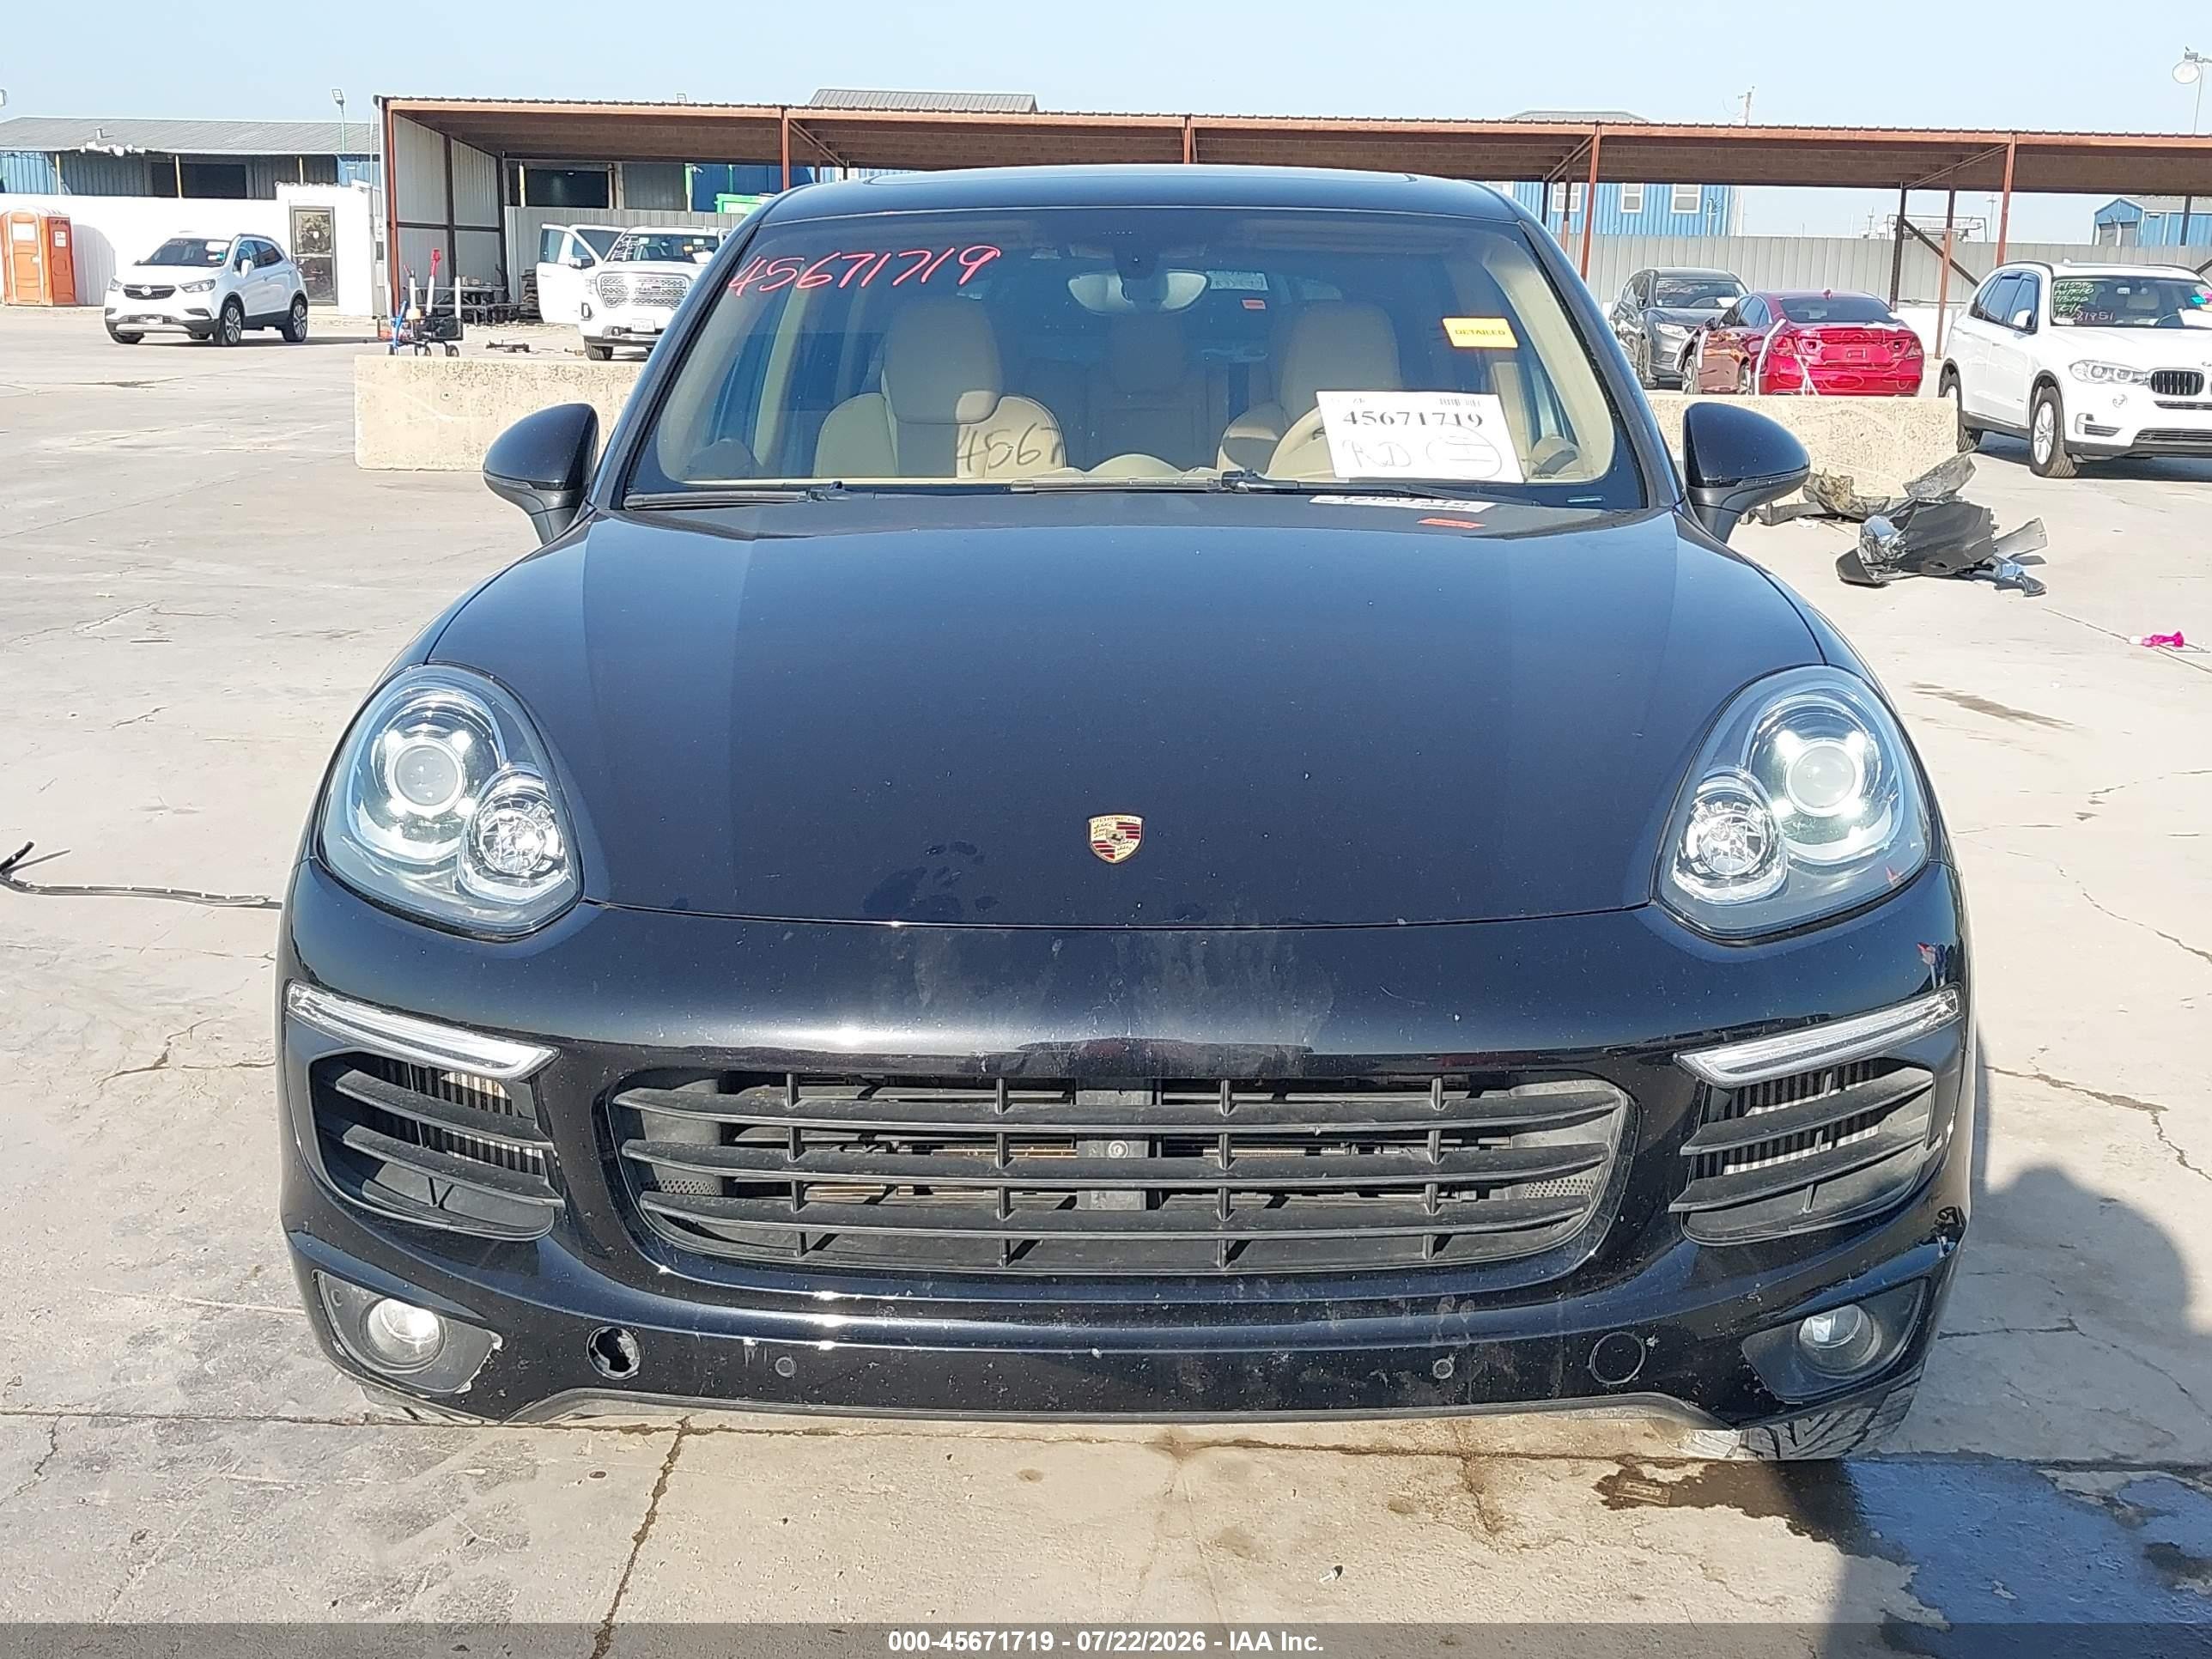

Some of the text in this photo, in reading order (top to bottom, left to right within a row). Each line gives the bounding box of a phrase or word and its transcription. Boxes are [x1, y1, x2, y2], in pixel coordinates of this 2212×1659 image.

[728, 245, 1001, 297] 45671719
[1454, 328, 1506, 337] DETAILED
[1342, 410, 1484, 428] 45671719
